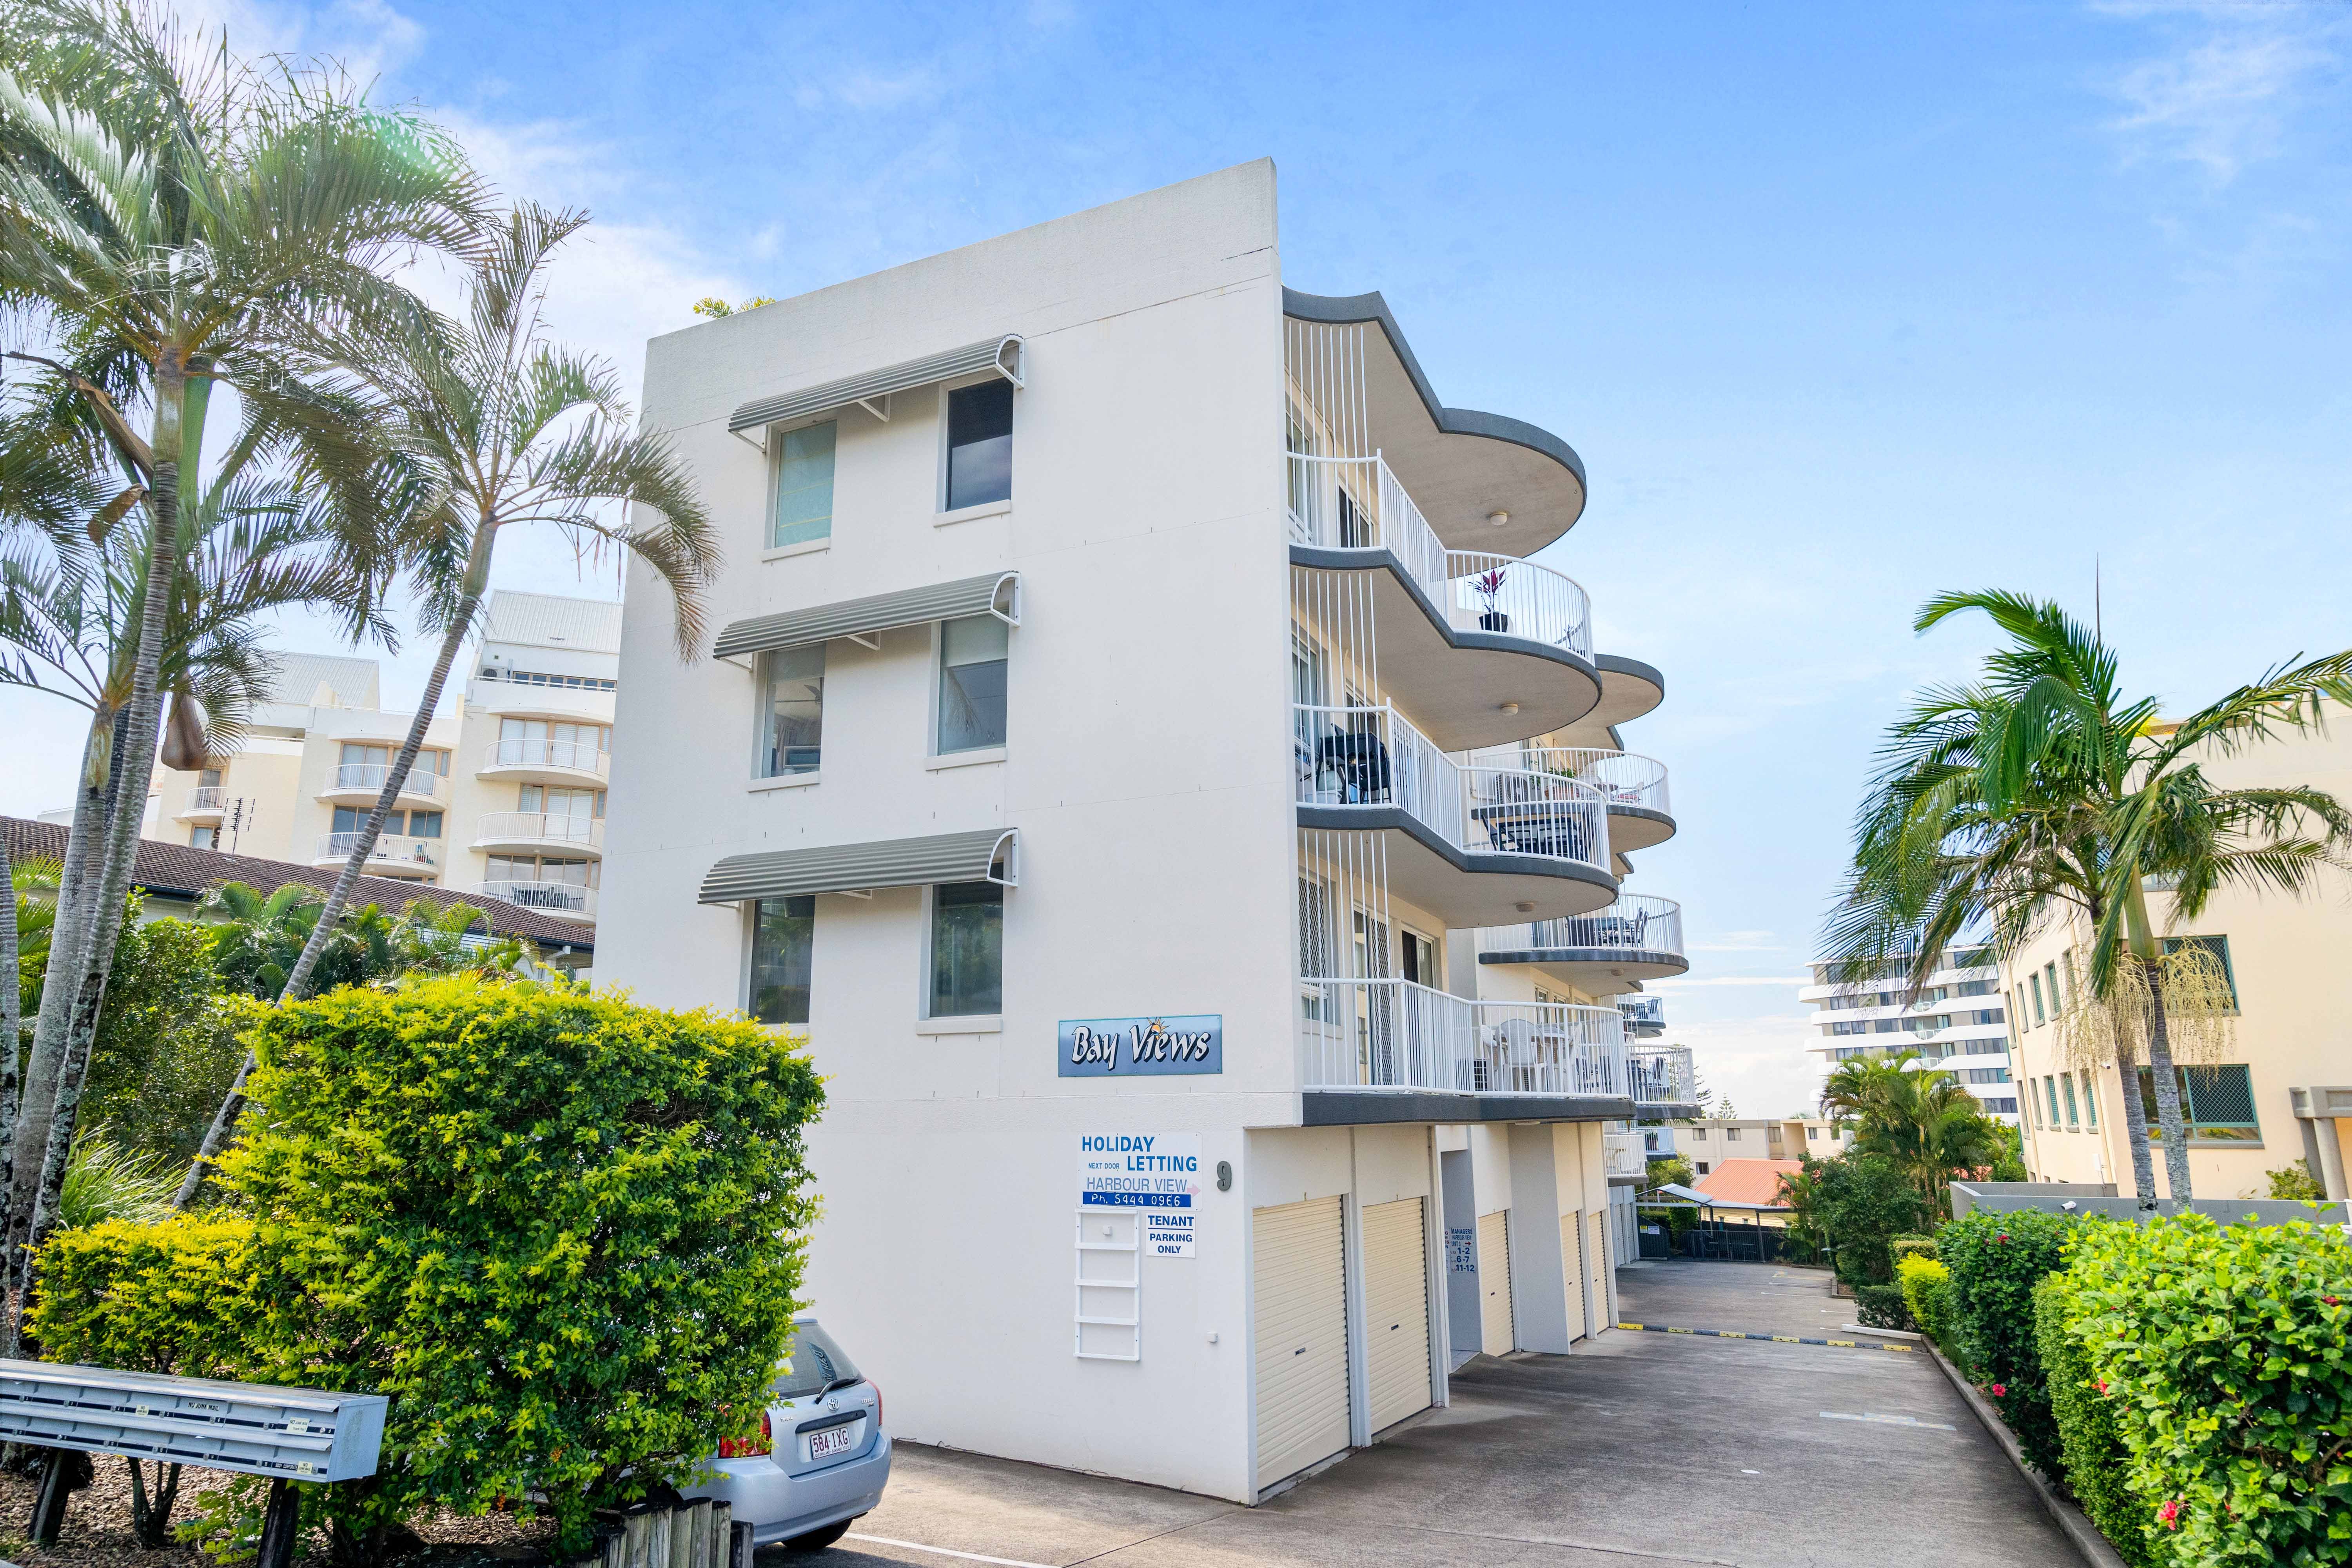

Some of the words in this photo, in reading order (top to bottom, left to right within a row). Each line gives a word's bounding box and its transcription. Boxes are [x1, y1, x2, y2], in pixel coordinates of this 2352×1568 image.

[1072, 1026, 1120, 1071] Bay
[1129, 1023, 1211, 1064] Views
[1082, 1136, 1155, 1152] HOLIDAY
[1127, 1156, 1197, 1172] LETTING
[1216, 1161, 1232, 1192] 9
[1087, 1177, 1149, 1191] HARBOUR
[1154, 1178, 1187, 1192] VIEW
[1091, 1193, 1108, 1204] Ph.
[1114, 1194, 1144, 1205] 5444
[1151, 1196, 1180, 1206] 0966
[1148, 1215, 1194, 1227] TENANT
[1150, 1233, 1192, 1242] PARKING
